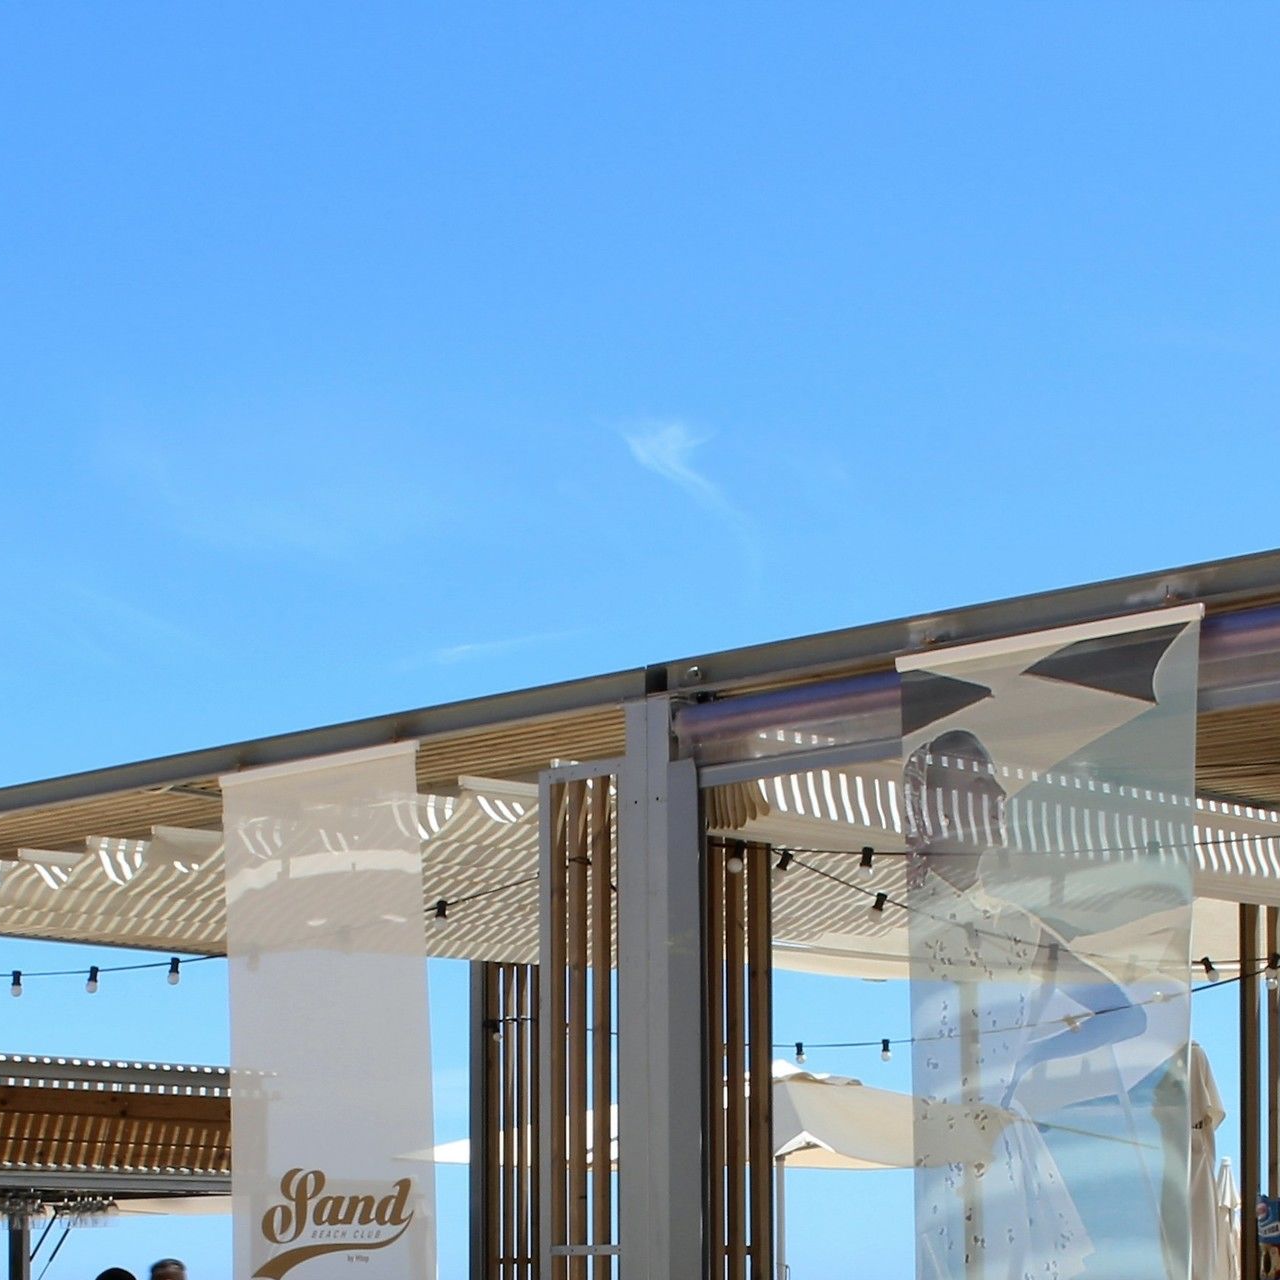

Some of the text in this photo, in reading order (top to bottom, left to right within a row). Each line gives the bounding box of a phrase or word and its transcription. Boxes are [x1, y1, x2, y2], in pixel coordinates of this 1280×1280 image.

[261, 1168, 414, 1244] Sand
[311, 1230, 381, 1239] BEACH CLUB
